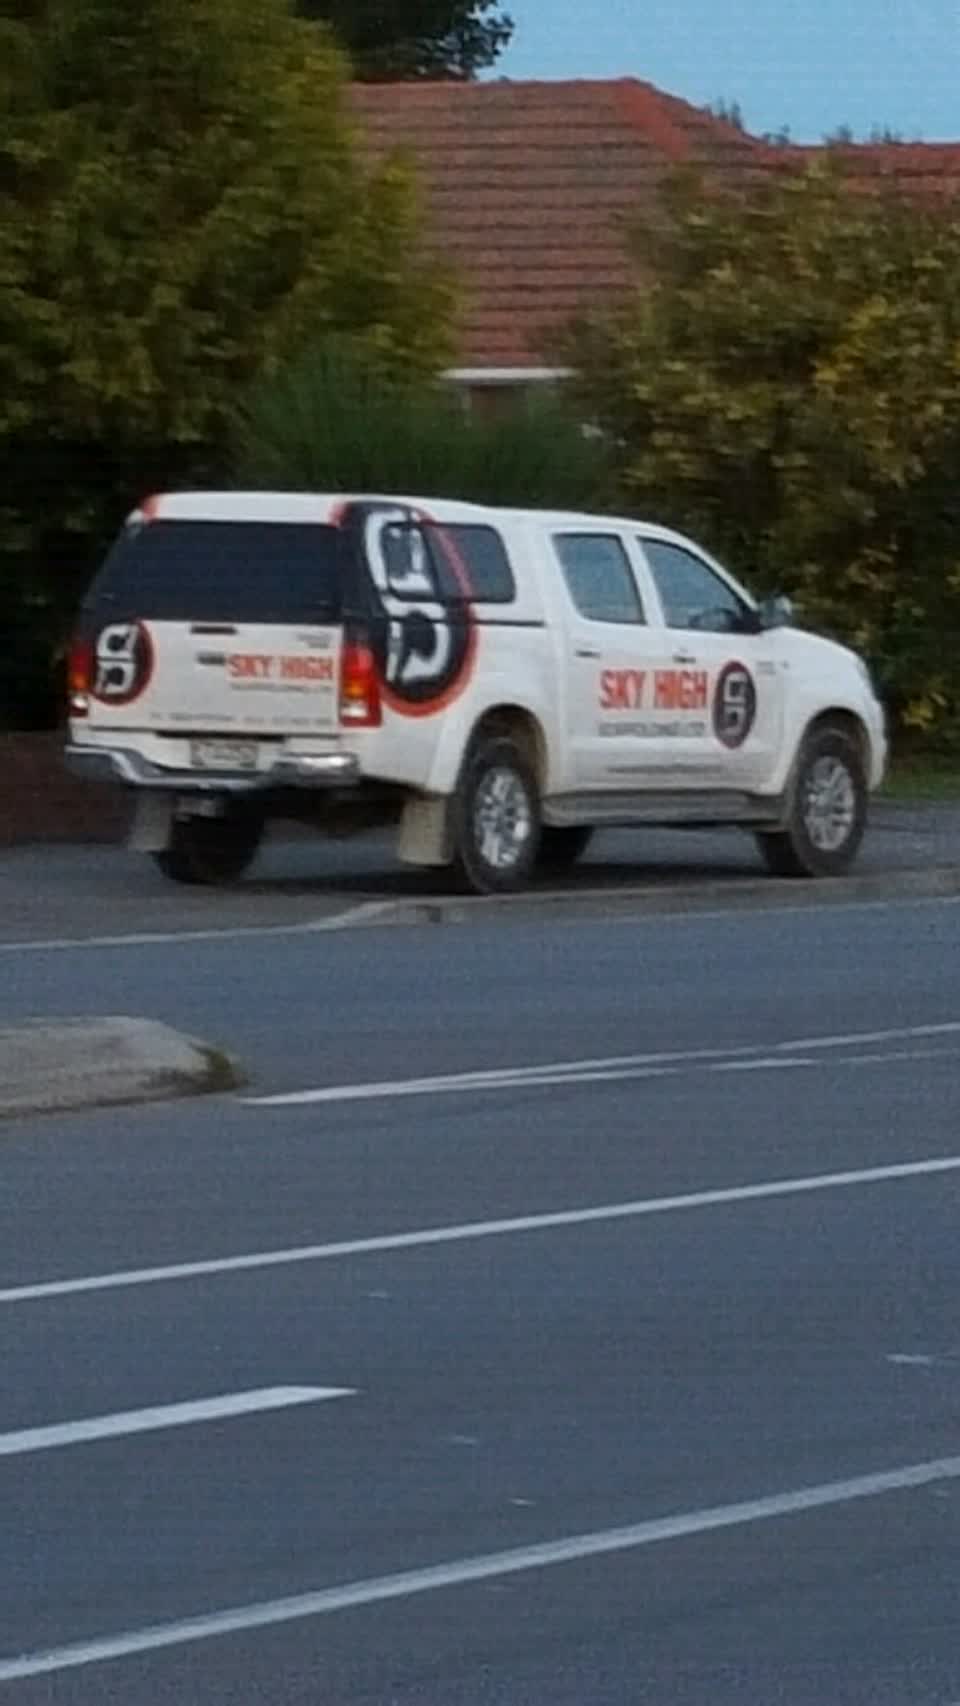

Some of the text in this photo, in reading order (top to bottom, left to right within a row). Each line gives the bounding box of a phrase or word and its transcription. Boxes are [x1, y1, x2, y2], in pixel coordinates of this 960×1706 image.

[228, 654, 333, 680] SKY HIGH
[600, 670, 708, 710] SKY HIGH
